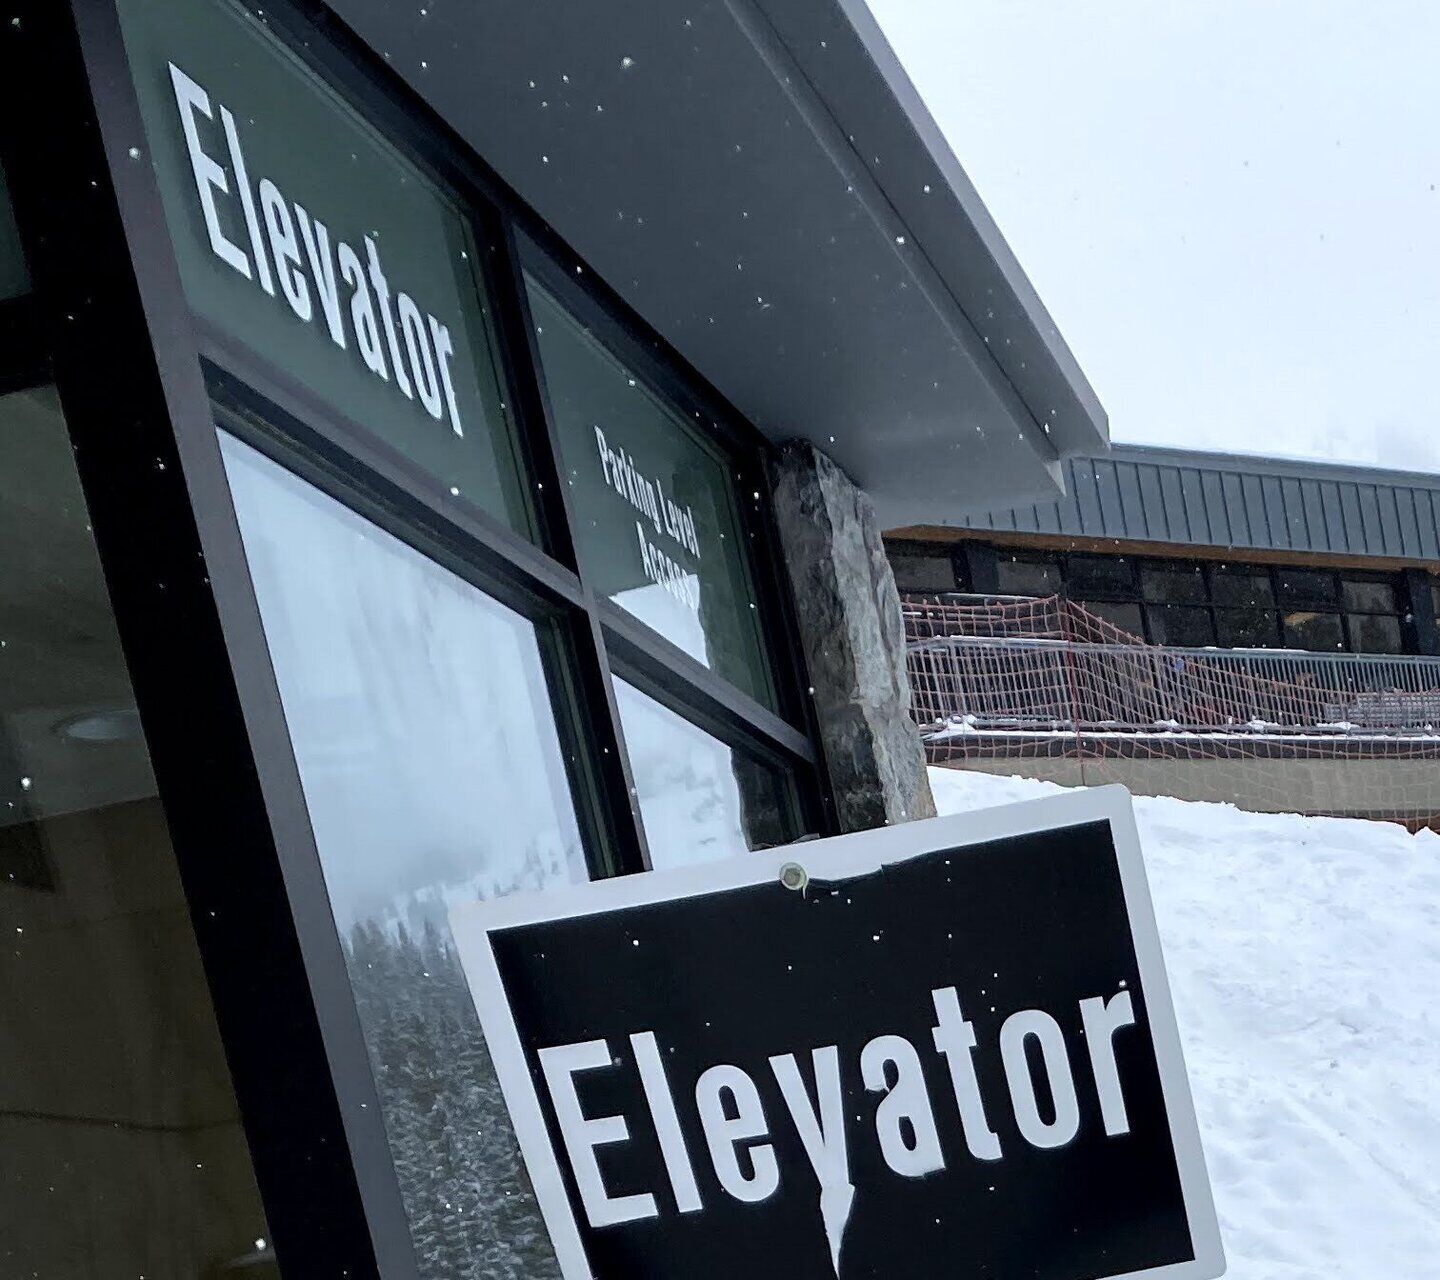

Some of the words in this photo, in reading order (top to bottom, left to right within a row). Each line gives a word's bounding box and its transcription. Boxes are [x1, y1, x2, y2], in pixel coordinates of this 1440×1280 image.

[168, 61, 463, 438] Elevator
[594, 425, 662, 534] Parking
[656, 478, 700, 559] Level
[537, 985, 1135, 1230] Elevator
